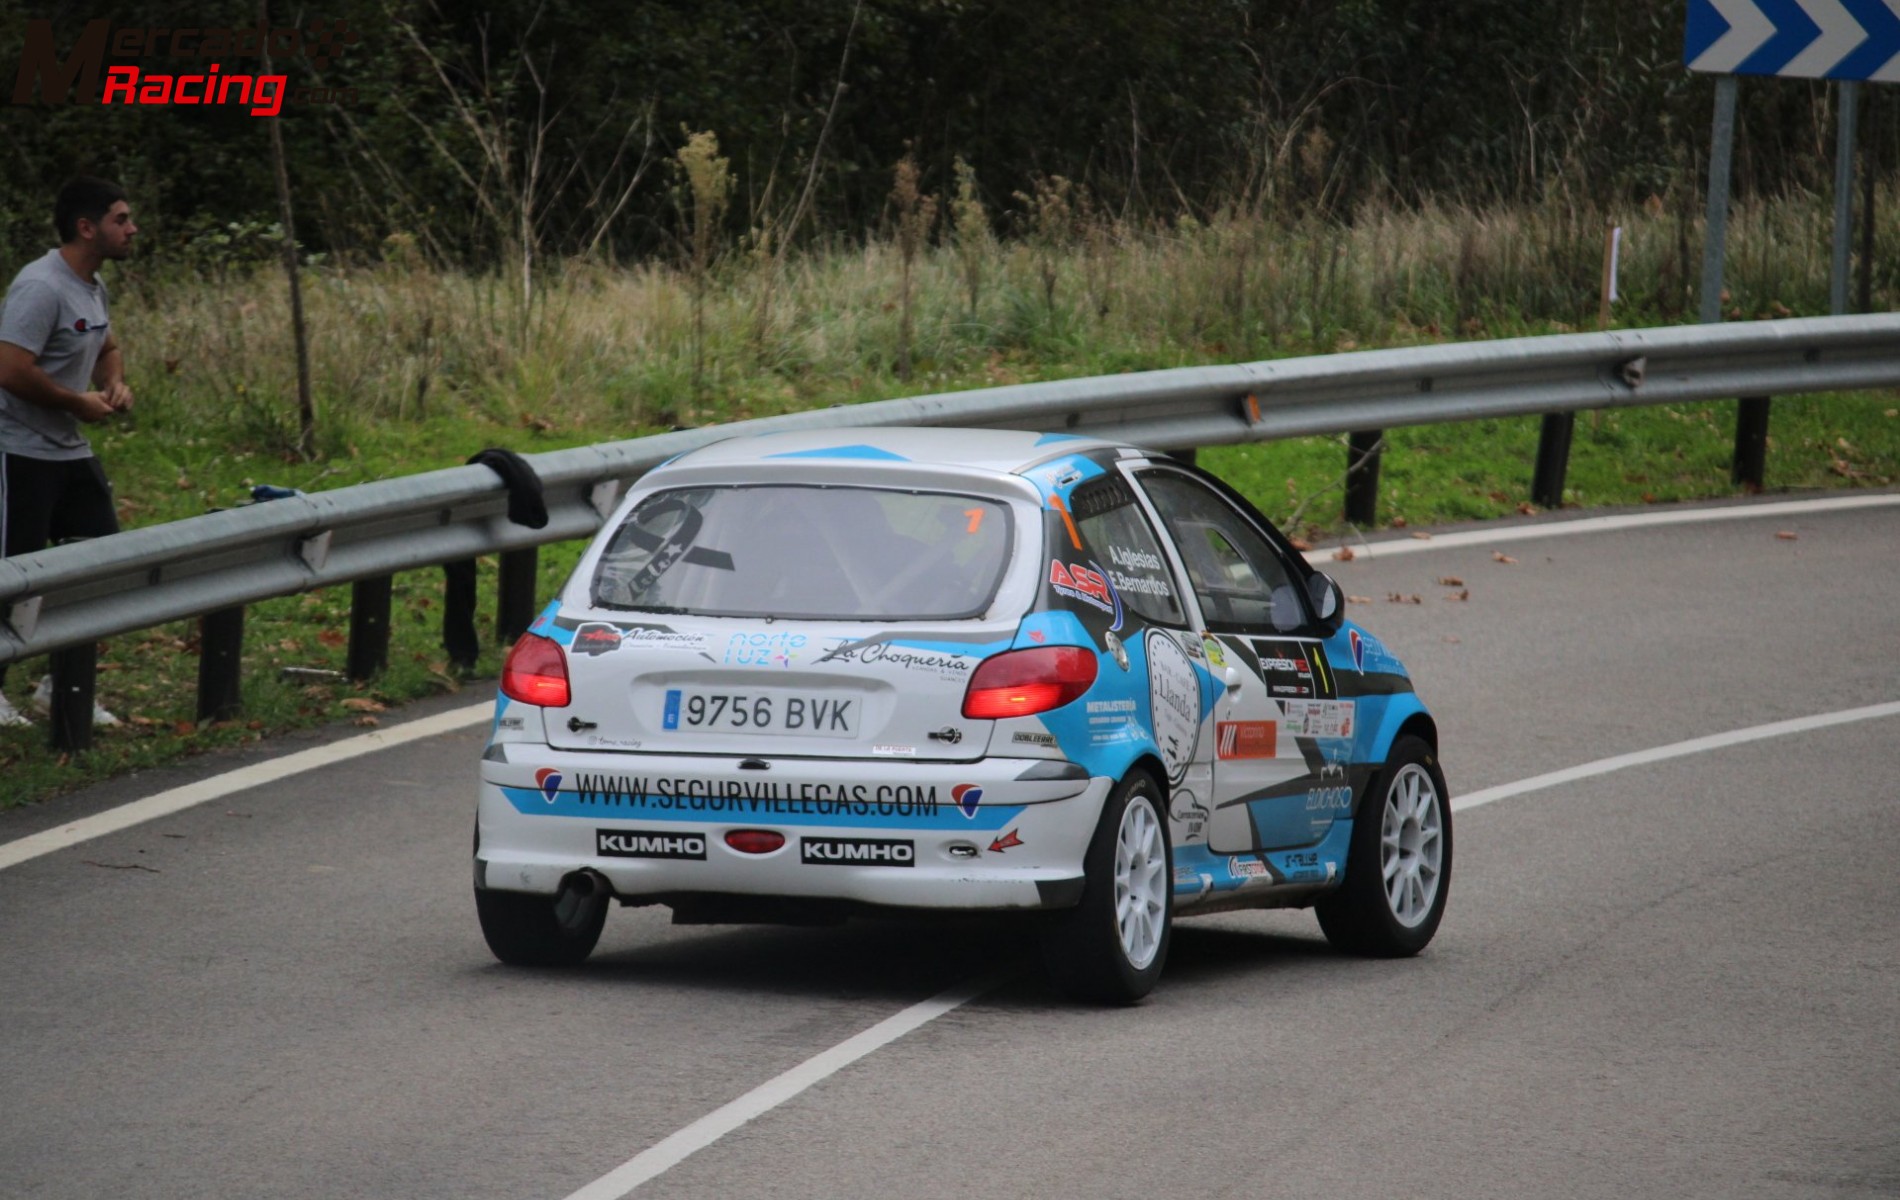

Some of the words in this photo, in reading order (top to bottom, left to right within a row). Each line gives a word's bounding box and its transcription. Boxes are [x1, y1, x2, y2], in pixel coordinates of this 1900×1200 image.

[963, 507, 985, 534] 1
[1050, 559, 1113, 605] ASR
[730, 631, 807, 648] norte
[819, 639, 859, 664] La
[1313, 647, 1329, 694] 1
[686, 695, 772, 727] 9756
[785, 698, 852, 731] BVK
[575, 772, 939, 818] WWW.SEGURVILLEGAS.COM
[599, 833, 705, 855] KUMHO
[803, 839, 913, 862] KUMHO
